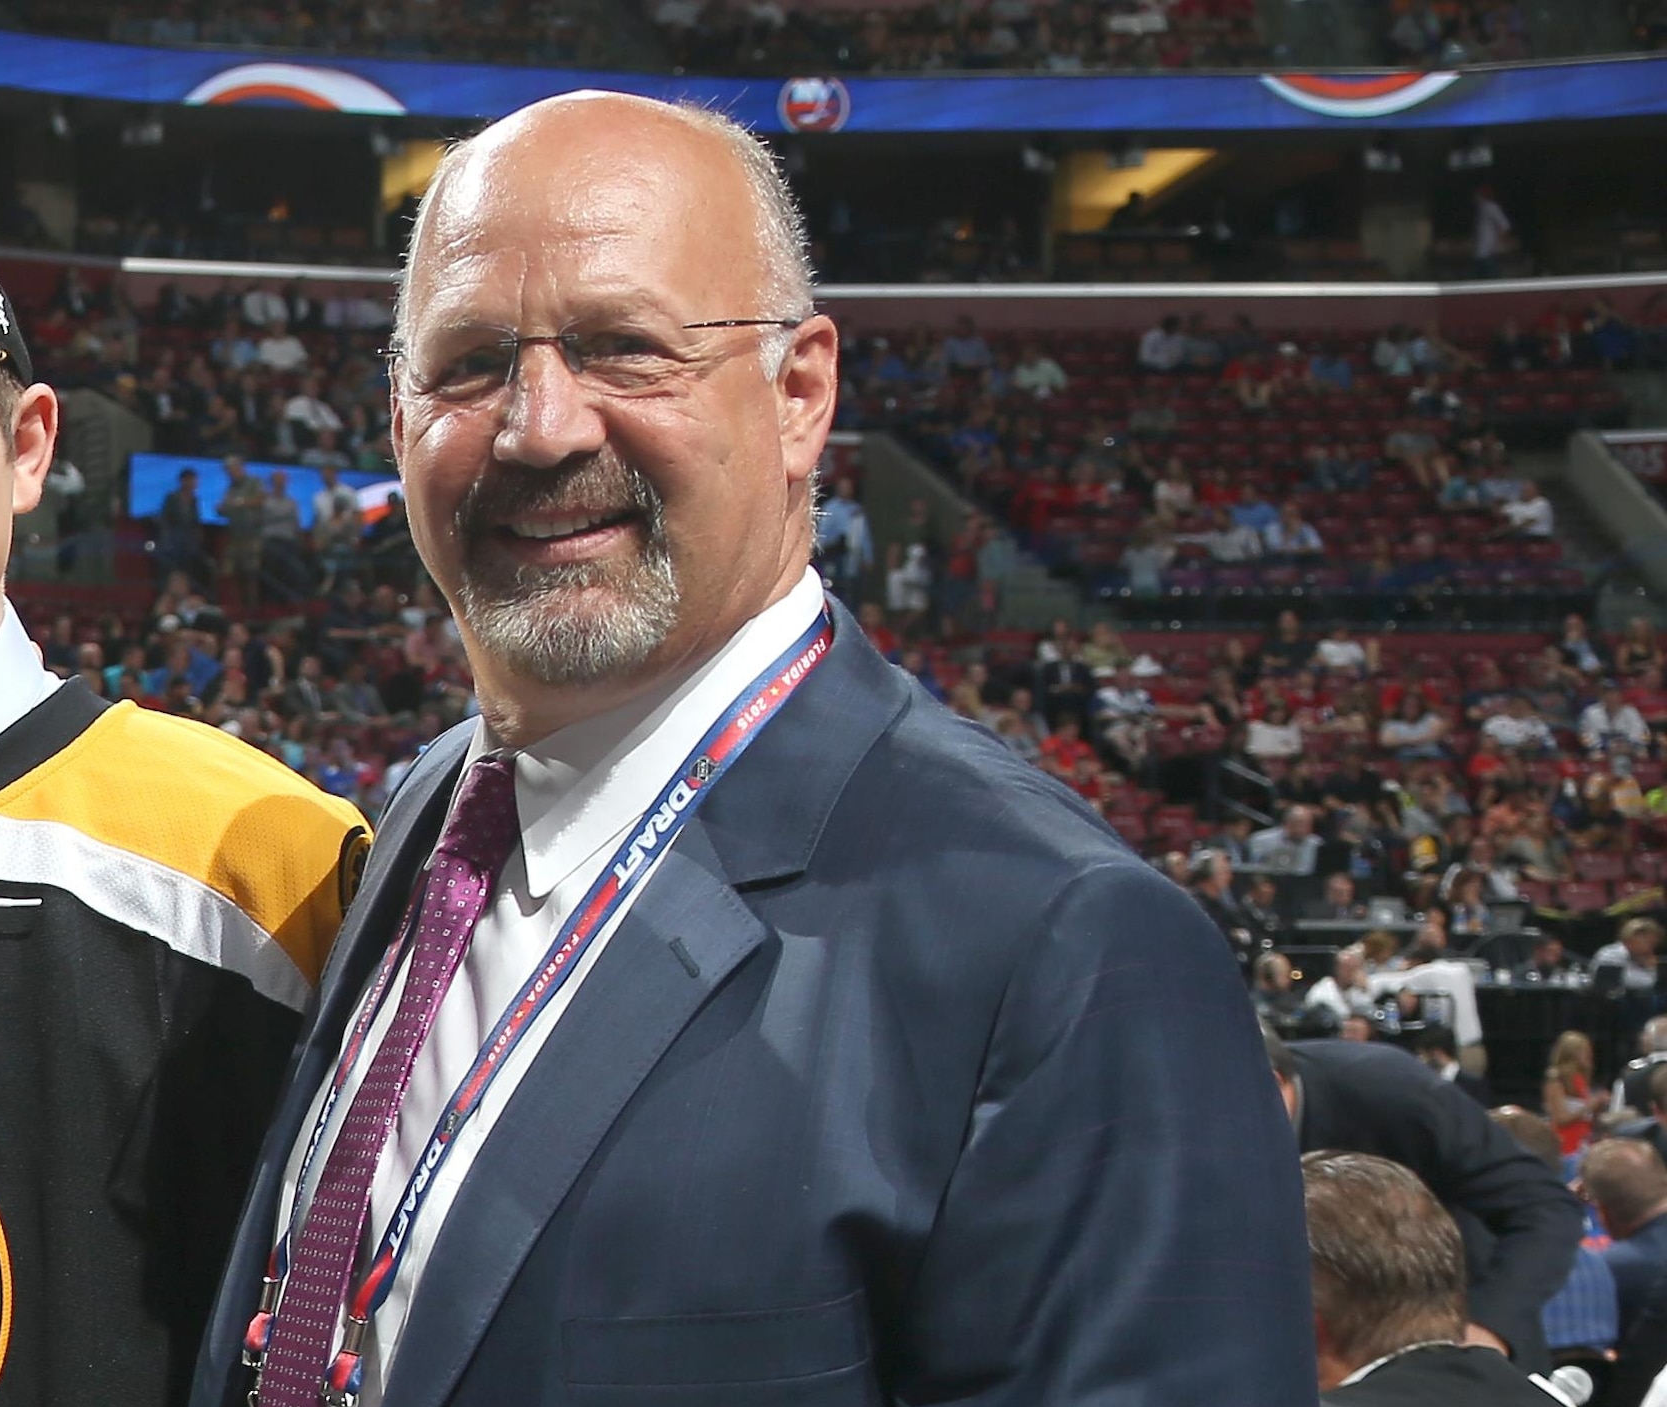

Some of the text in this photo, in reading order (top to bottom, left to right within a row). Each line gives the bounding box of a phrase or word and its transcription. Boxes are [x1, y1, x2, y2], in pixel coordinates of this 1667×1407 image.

[736, 637, 827, 731] FLORIDA 2015
[613, 779, 698, 890] DRAFT
[526, 932, 580, 1004] FLORIDA
[389, 1135, 446, 1259] DRAFT
